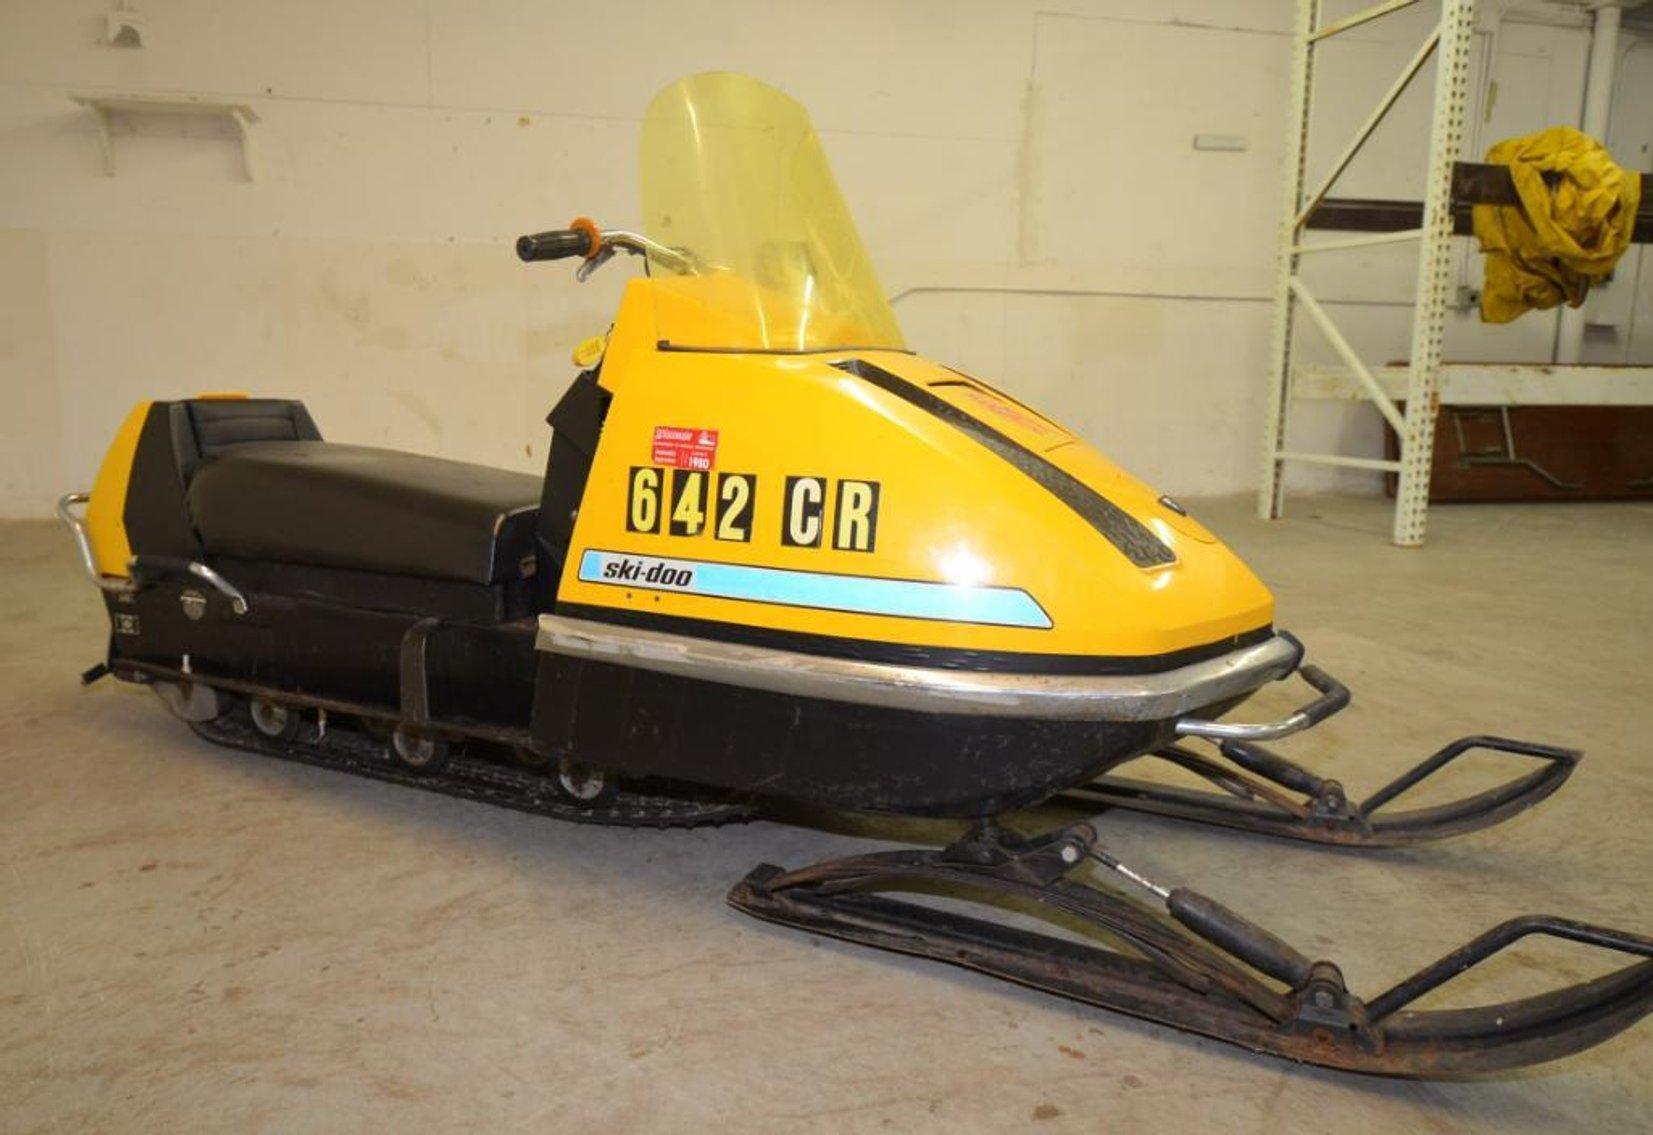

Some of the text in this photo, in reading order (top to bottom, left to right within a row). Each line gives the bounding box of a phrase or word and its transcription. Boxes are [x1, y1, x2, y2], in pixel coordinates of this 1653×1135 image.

[631, 468, 873, 550] 642 CR
[604, 559, 693, 587] ski-doo
